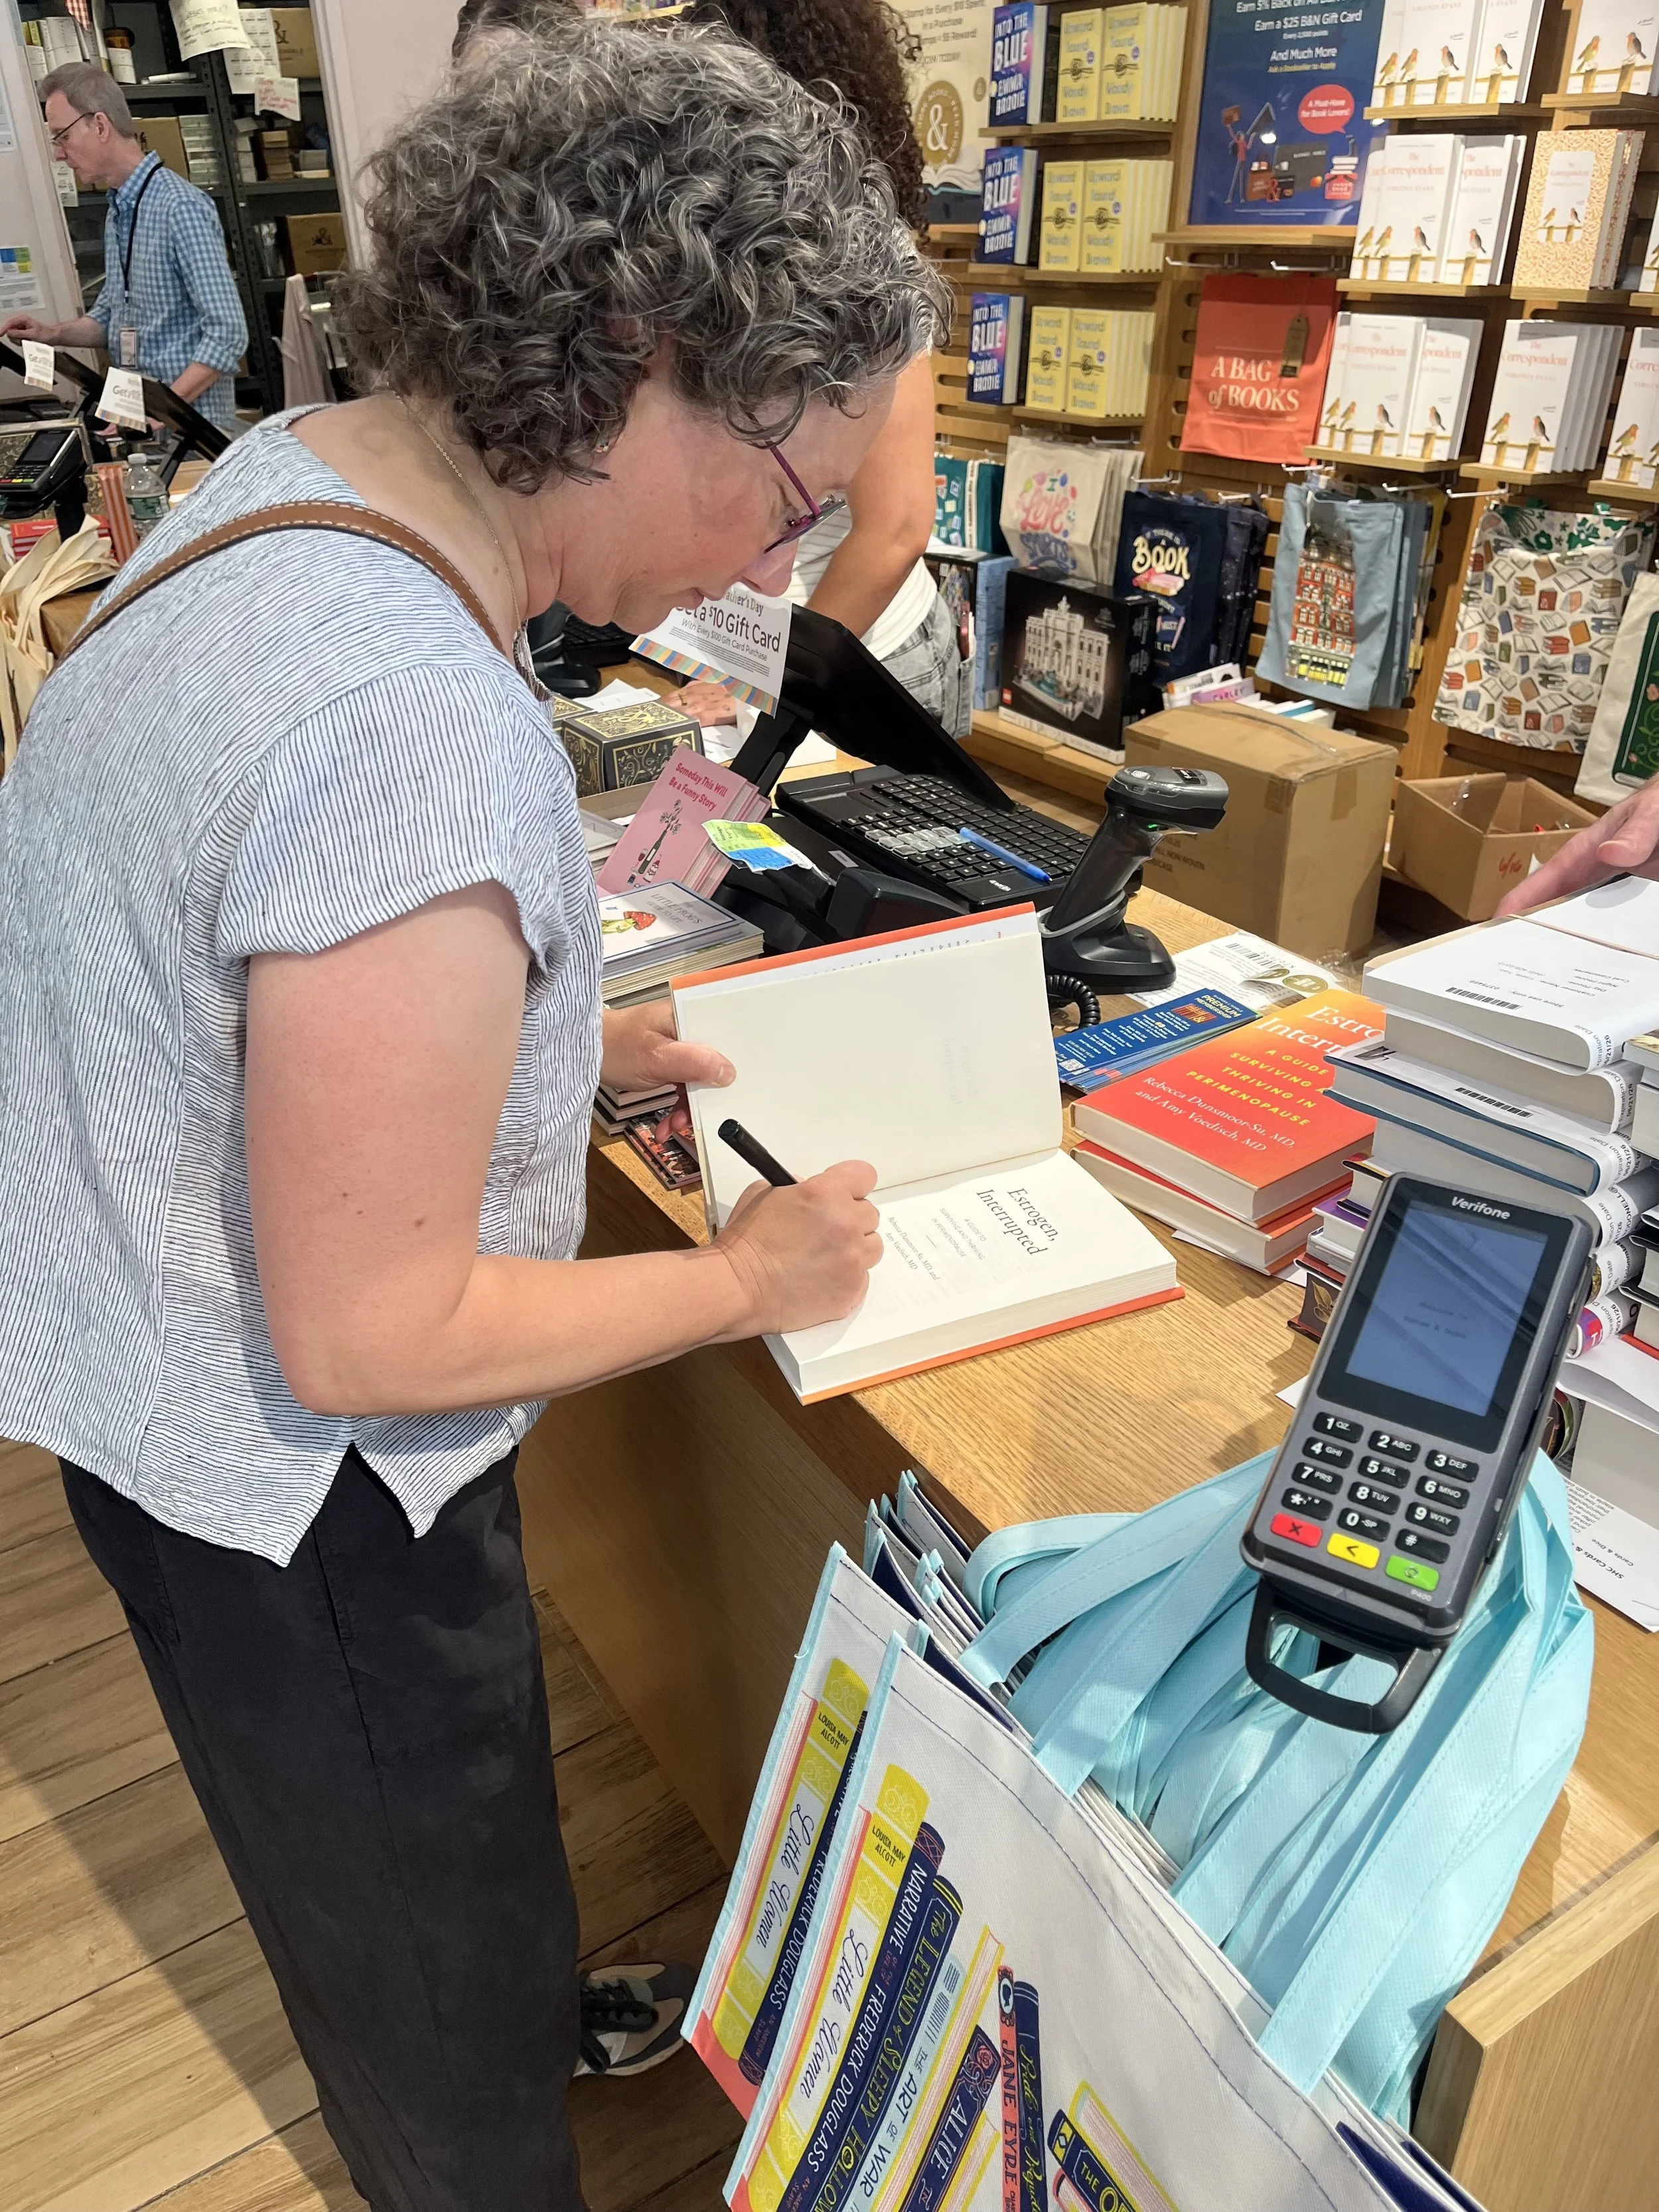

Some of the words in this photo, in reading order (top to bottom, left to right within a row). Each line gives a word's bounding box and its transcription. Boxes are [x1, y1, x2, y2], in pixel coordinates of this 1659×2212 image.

[995, 19, 1013, 38] INTO
[1015, 12, 1028, 30] THE
[1255, 20, 1275, 31] Earn
[1275, 21, 1282, 29] a
[1282, 17, 1299, 29] $25
[1300, 15, 1321, 27] B&N
[1322, 13, 1339, 25] Gift
[1340, 9, 1363, 23] Card
[994, 30, 1028, 72] BLUE
[1270, 50, 1289, 61] And
[1289, 48, 1313, 60] Much
[1314, 46, 1338, 58] More
[998, 74, 1023, 97] EMMA
[986, 162, 1003, 179] INTO
[1003, 155, 1018, 174] THE
[1384, 163, 1445, 179] Correspondent
[983, 174, 1017, 211] BLUE
[973, 306, 988, 319] INTO
[989, 303, 1003, 318] THE
[972, 321, 1003, 352] BLUE
[1346, 344, 1407, 360] Correspondent
[1502, 350, 1567, 367] Correspondent
[1211, 356, 1225, 378] A
[1229, 357, 1272, 382] BAG
[1208, 385, 1227, 409] of
[1228, 385, 1299, 411] BOOKS
[725, 592, 749, 609] ather's
[751, 598, 764, 617] Day
[682, 618, 696, 630] With
[697, 626, 710, 638] Every
[711, 631, 721, 642] $100
[721, 634, 731, 646] Gift
[732, 640, 745, 652] Card
[745, 645, 768, 662] Purchase
[699, 607, 707, 622] a
[709, 605, 724, 628] $10
[726, 613, 749, 640] Gift
[752, 624, 781, 653] Card
[676, 763, 703, 785] Someday
[701, 776, 714, 790] This
[714, 783, 729, 797] Will
[669, 776, 678, 788] Be
[681, 784, 700, 802] Funny
[699, 794, 717, 812] Story
[651, 893, 676, 909] LITTLE
[675, 907, 703, 924] FROG'S
[1194, 997, 1232, 1020] MEMBERSHIP
[1201, 995, 1242, 1017] PREMIUM
[1575, 1024, 1593, 1035] Date
[1230, 1052, 1312, 1088] SURVIVING
[1281, 1054, 1330, 1076] GUIDE
[1603, 1070, 1621, 1082] Date
[1186, 1070, 1312, 1126] PERIMENOPAUSE
[1222, 1067, 1293, 1100] THRIVING
[1296, 1098, 1317, 1109] IN
[1135, 1090, 1155, 1102] and
[1156, 1100, 1187, 1116] Amy
[1188, 1112, 1238, 1140] Voedisch,
[1242, 1138, 1267, 1152] MD
[1143, 1076, 1187, 1100] Rebecca
[1187, 1095, 1267, 1136] Dunsmoor-Su,
[1269, 1134, 1295, 1149] MD,
[1589, 1136, 1609, 1147] Date
[1007, 1187, 1059, 1242] Estrogen,
[1451, 1196, 1510, 1220] Verifone
[939, 1208, 961, 1230] SURVIVING
[966, 1238, 985, 1260] THRIVING
[976, 1189, 1048, 1256] Interrupted
[936, 1222, 966, 1258] PERIMENOPAUSE
[1327, 1418, 1334, 1430] 1
[1311, 1442, 1323, 1455] 4
[1325, 1446, 1342, 1457] GHI
[1377, 1435, 1391, 1449] 2
[1392, 1439, 1412, 1451] ABC
[1301, 1466, 1314, 1479] 7
[1314, 1471, 1333, 1483] PRS
[1366, 1460, 1380, 1474] 5
[1381, 1465, 1396, 1477] JKL
[1434, 1455, 1447, 1467] 3
[1448, 1459, 1468, 1470] DEF
[1356, 1486, 1370, 1500] 8
[1371, 1491, 1390, 1503] TUV
[1424, 1481, 1437, 1494] 6
[1438, 1485, 1461, 1499] MNO
[1346, 1513, 1359, 1526] 0
[1413, 1507, 1427, 1520] 9
[1430, 1513, 1452, 1525] WXY
[1591, 1538, 1607, 1550] Dice
[1584, 1551, 1606, 1567] Cards
[1615, 1552, 1634, 1566] Cards
[1605, 1566, 1624, 1579] SHC
[1411, 1589, 1431, 1601] P400
[818, 1712, 837, 1733] LOUISA
[836, 1730, 849, 1745] MAY
[820, 1728, 839, 1750] ALCOTT
[781, 1804, 815, 1875] Little
[872, 1826, 893, 1849] LOUISA
[893, 1846, 905, 1863] MAY
[875, 1843, 897, 1868] ALCOTT
[757, 1881, 790, 1948] Women
[889, 1862, 928, 1955] NARRATIVE
[930, 1909, 947, 1939] The
[770, 1925, 806, 2010] DOUGLASS
[831, 1929, 868, 2013] Little
[897, 1936, 932, 2026] LEGEND
[847, 1983, 887, 2078] FREDERICK
[893, 2024, 904, 2046] of
[800, 2018, 841, 2099] Women
[914, 2047, 928, 2073] THE
[861, 2037, 901, 2127] SLEEPY
[1002, 2039, 1016, 2108] JANE
[1020, 2044, 1038, 2111] Pride
[896, 2072, 917, 2122] ART
[808, 2073, 854, 2173] DOUGLASS
[887, 2121, 898, 2142] OF
[930, 2095, 968, 2179] ALICE
[1004, 2120, 1018, 2187] EYRE
[860, 2144, 891, 2197] WAR
[1080, 2162, 1100, 2193] THE
